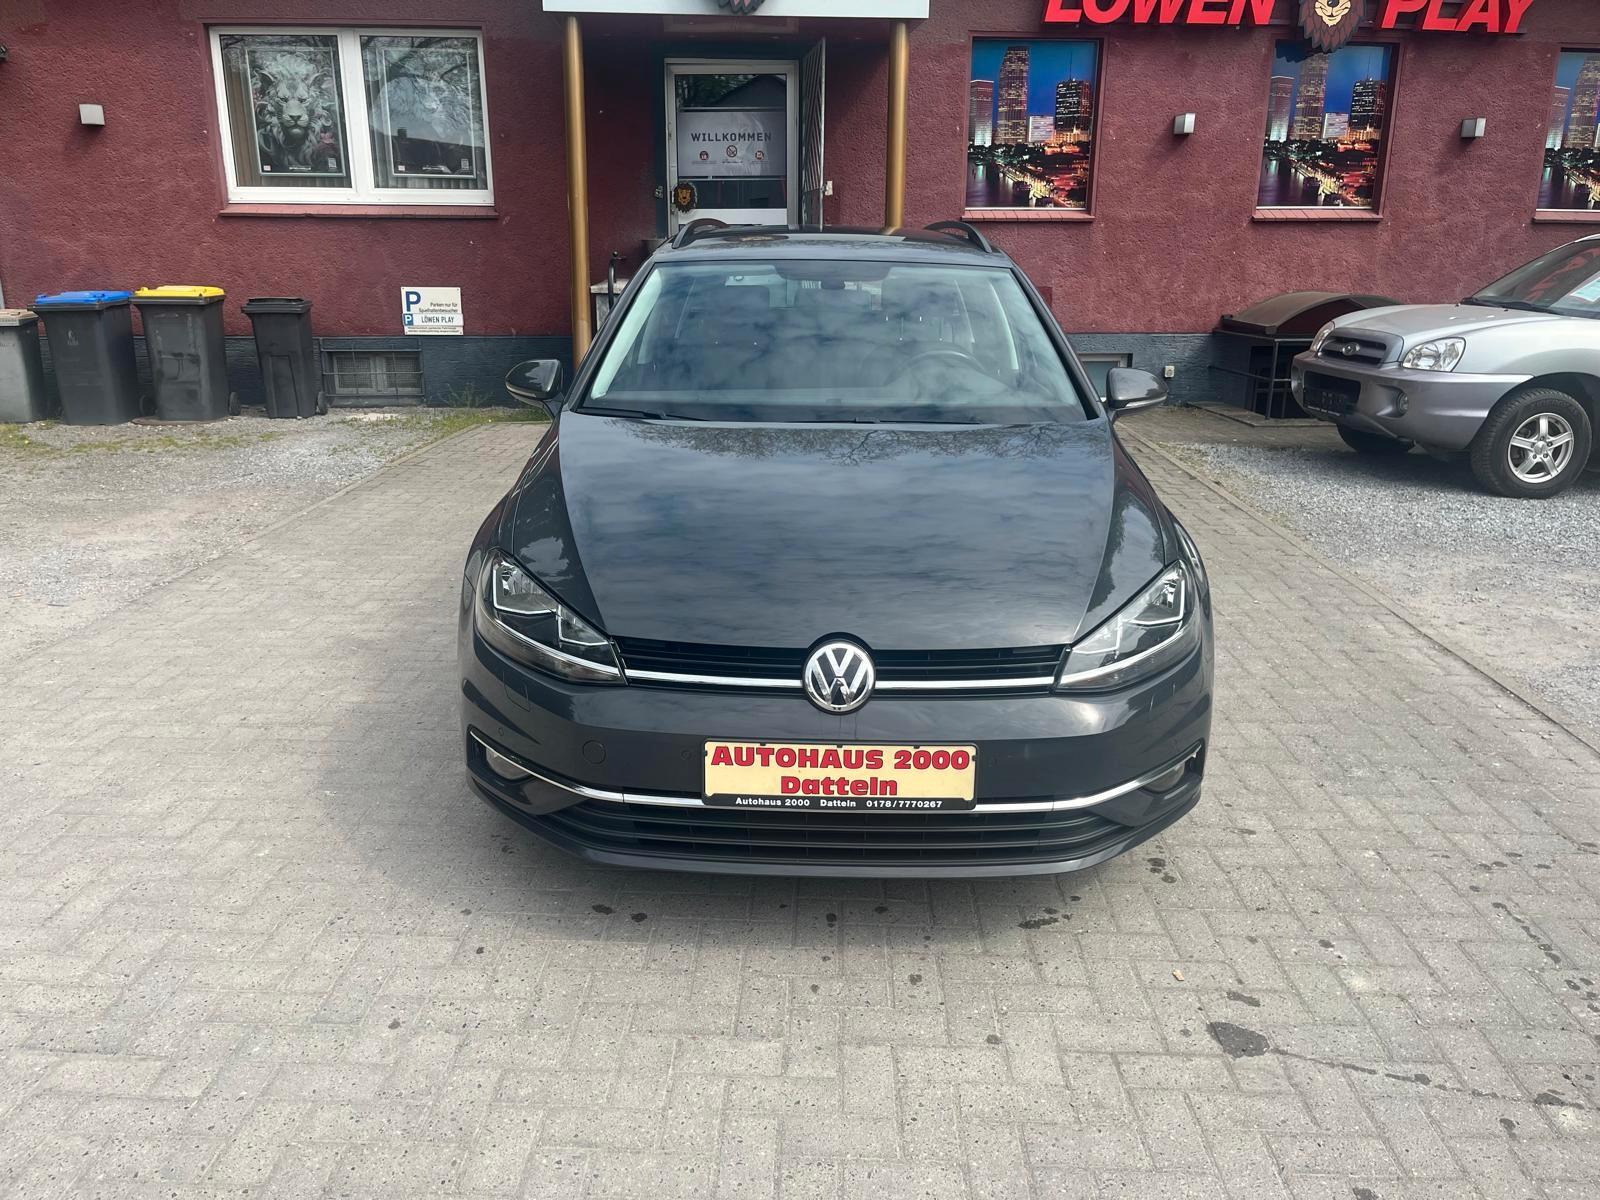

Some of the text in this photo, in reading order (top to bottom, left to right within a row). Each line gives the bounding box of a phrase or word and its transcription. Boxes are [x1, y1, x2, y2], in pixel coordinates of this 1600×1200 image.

[1381, 0, 1534, 33] PLAY
[691, 132, 772, 142] WILLKOMMEN
[405, 291, 421, 312] P
[405, 315, 412, 324] P
[421, 315, 440, 323] LÖWEN
[711, 746, 970, 770] AUTOHAUS 2000
[781, 776, 898, 796] Datteln
[735, 797, 943, 808] Autohaus 2000 Datteln 0178/7770267
